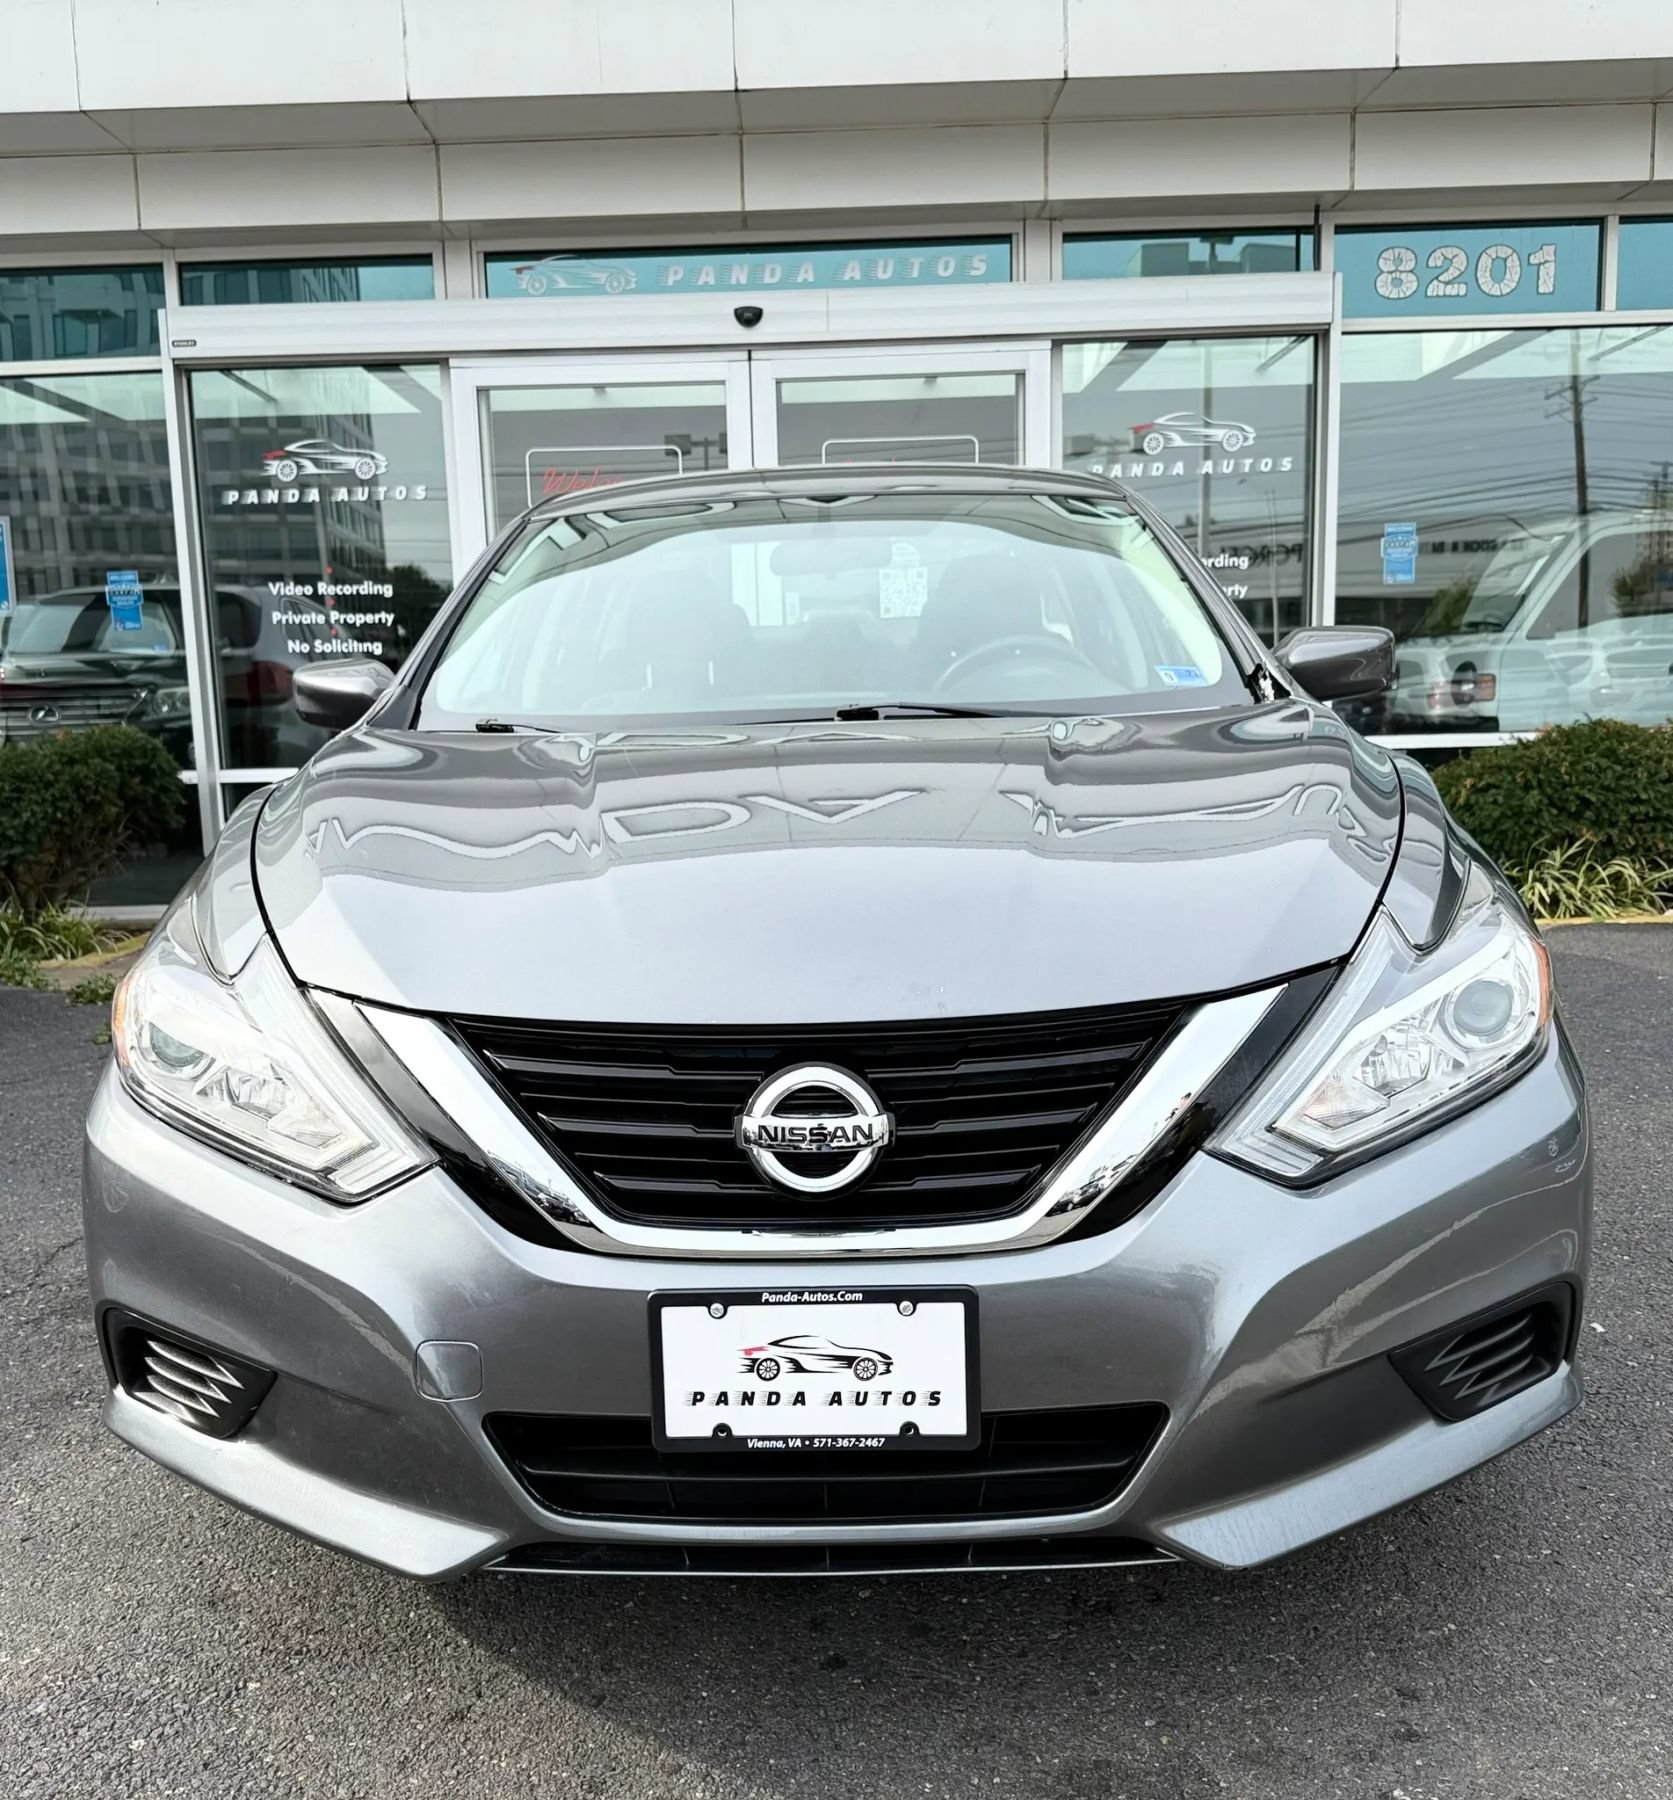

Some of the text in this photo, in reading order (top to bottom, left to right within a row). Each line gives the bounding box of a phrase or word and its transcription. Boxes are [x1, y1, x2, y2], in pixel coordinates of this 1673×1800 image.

[660, 254, 987, 286] PANDA AUTOS
[1375, 243, 1557, 299] 8201
[1201, 457, 1293, 474] AUTOS
[224, 485, 426, 505] PANDA AUTOS
[268, 580, 393, 598] Video Recording
[271, 610, 395, 627] Private Property
[287, 638, 382, 656] No Soliciting
[757, 1123, 873, 1144] NISSAN
[761, 1290, 863, 1304] Panda-Autos.Com
[688, 1390, 942, 1406] PANDA AUTOS
[747, 1436, 885, 1449] Vienna, VA 571-367-2467
